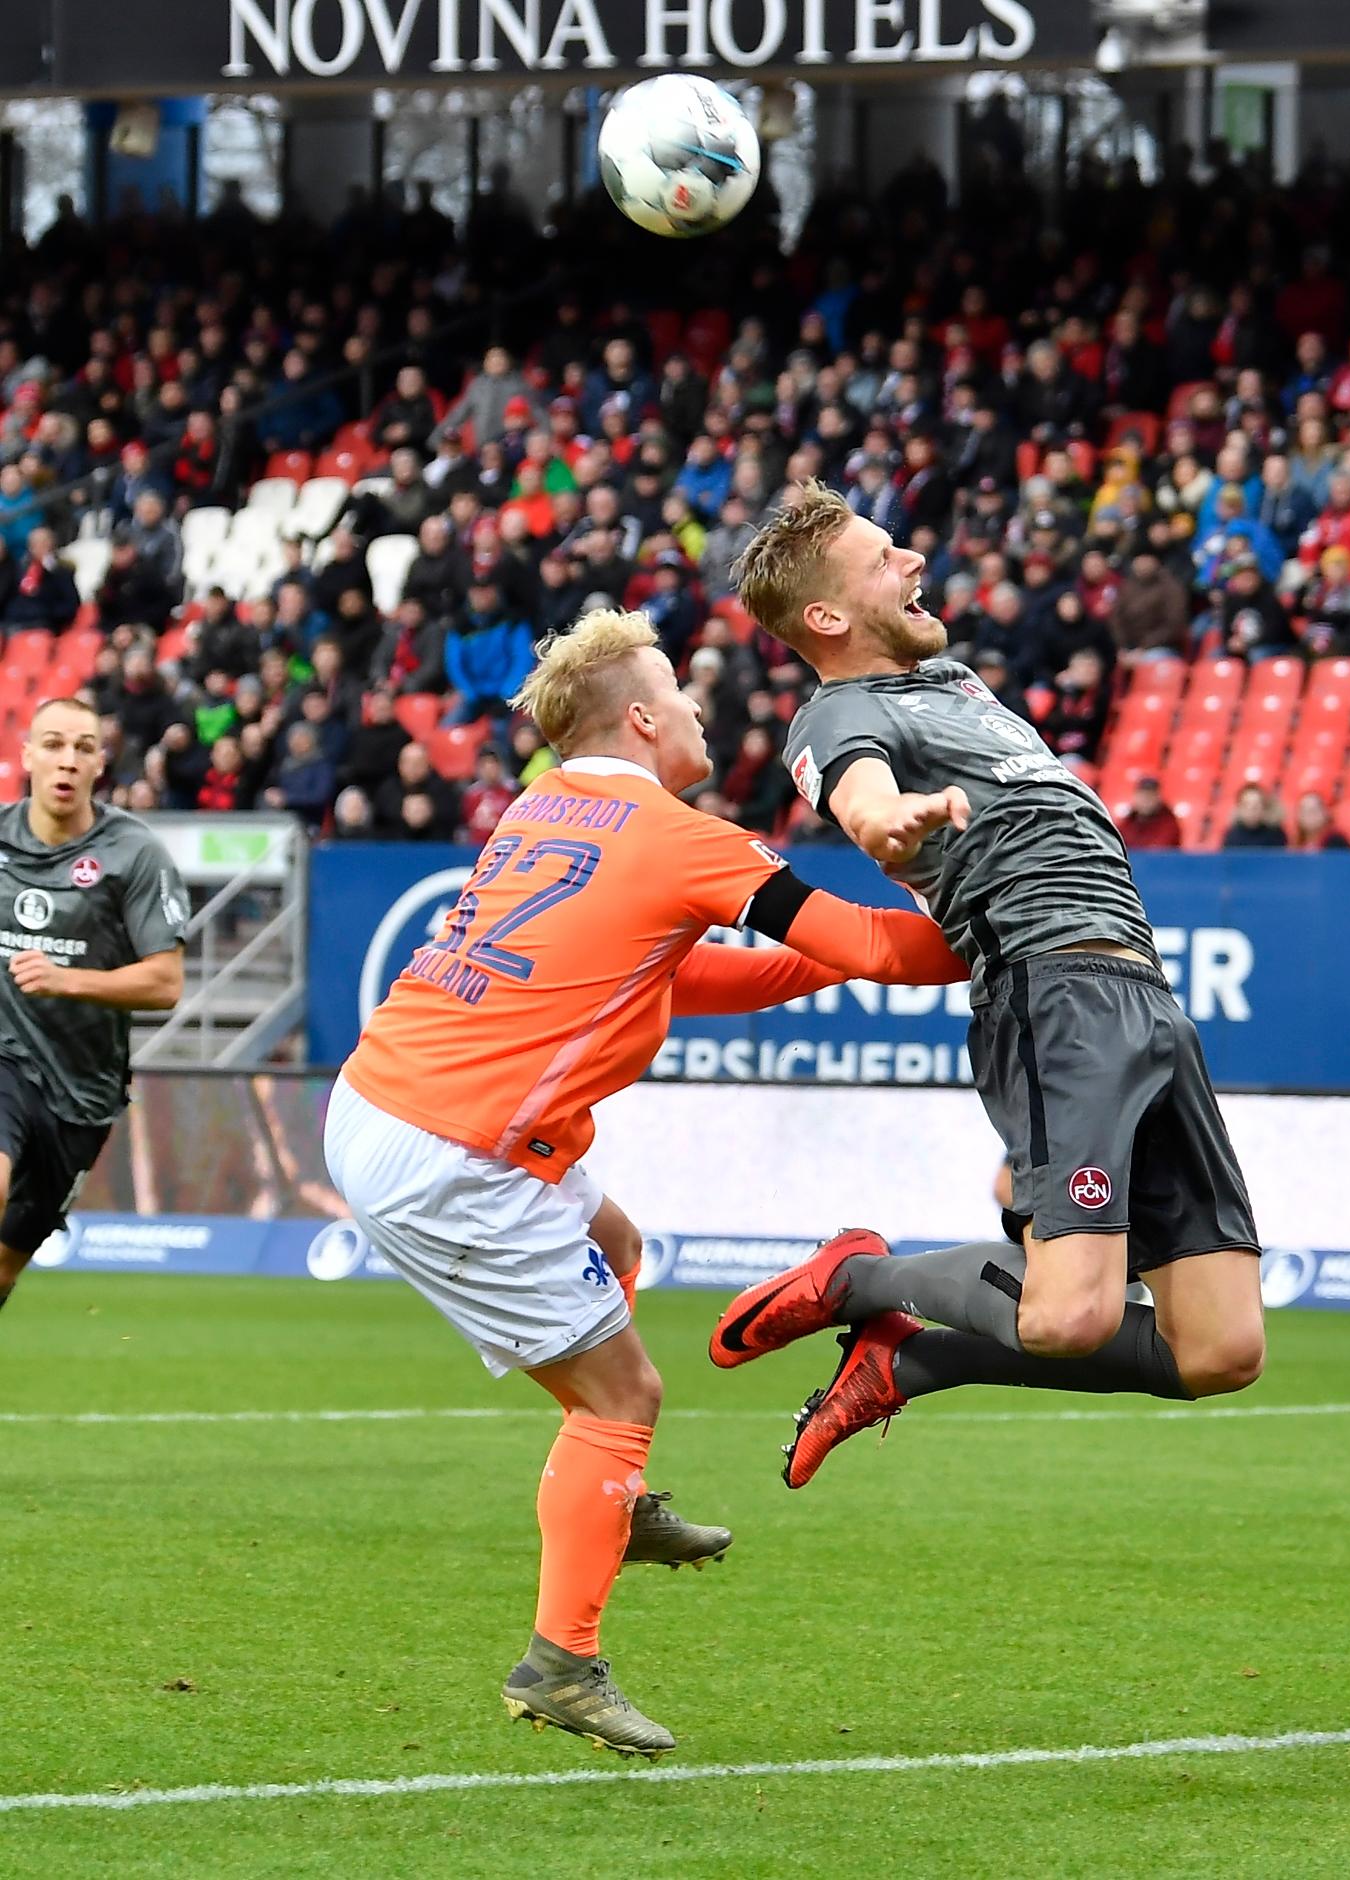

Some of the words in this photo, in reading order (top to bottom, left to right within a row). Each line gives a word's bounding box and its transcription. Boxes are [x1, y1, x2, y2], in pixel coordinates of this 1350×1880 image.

[221, 0, 618, 78] NOVINA
[635, 0, 1036, 69] HOTELS
[408, 948, 491, 1006] OLLAND
[1074, 1184, 1108, 1200] FCN
